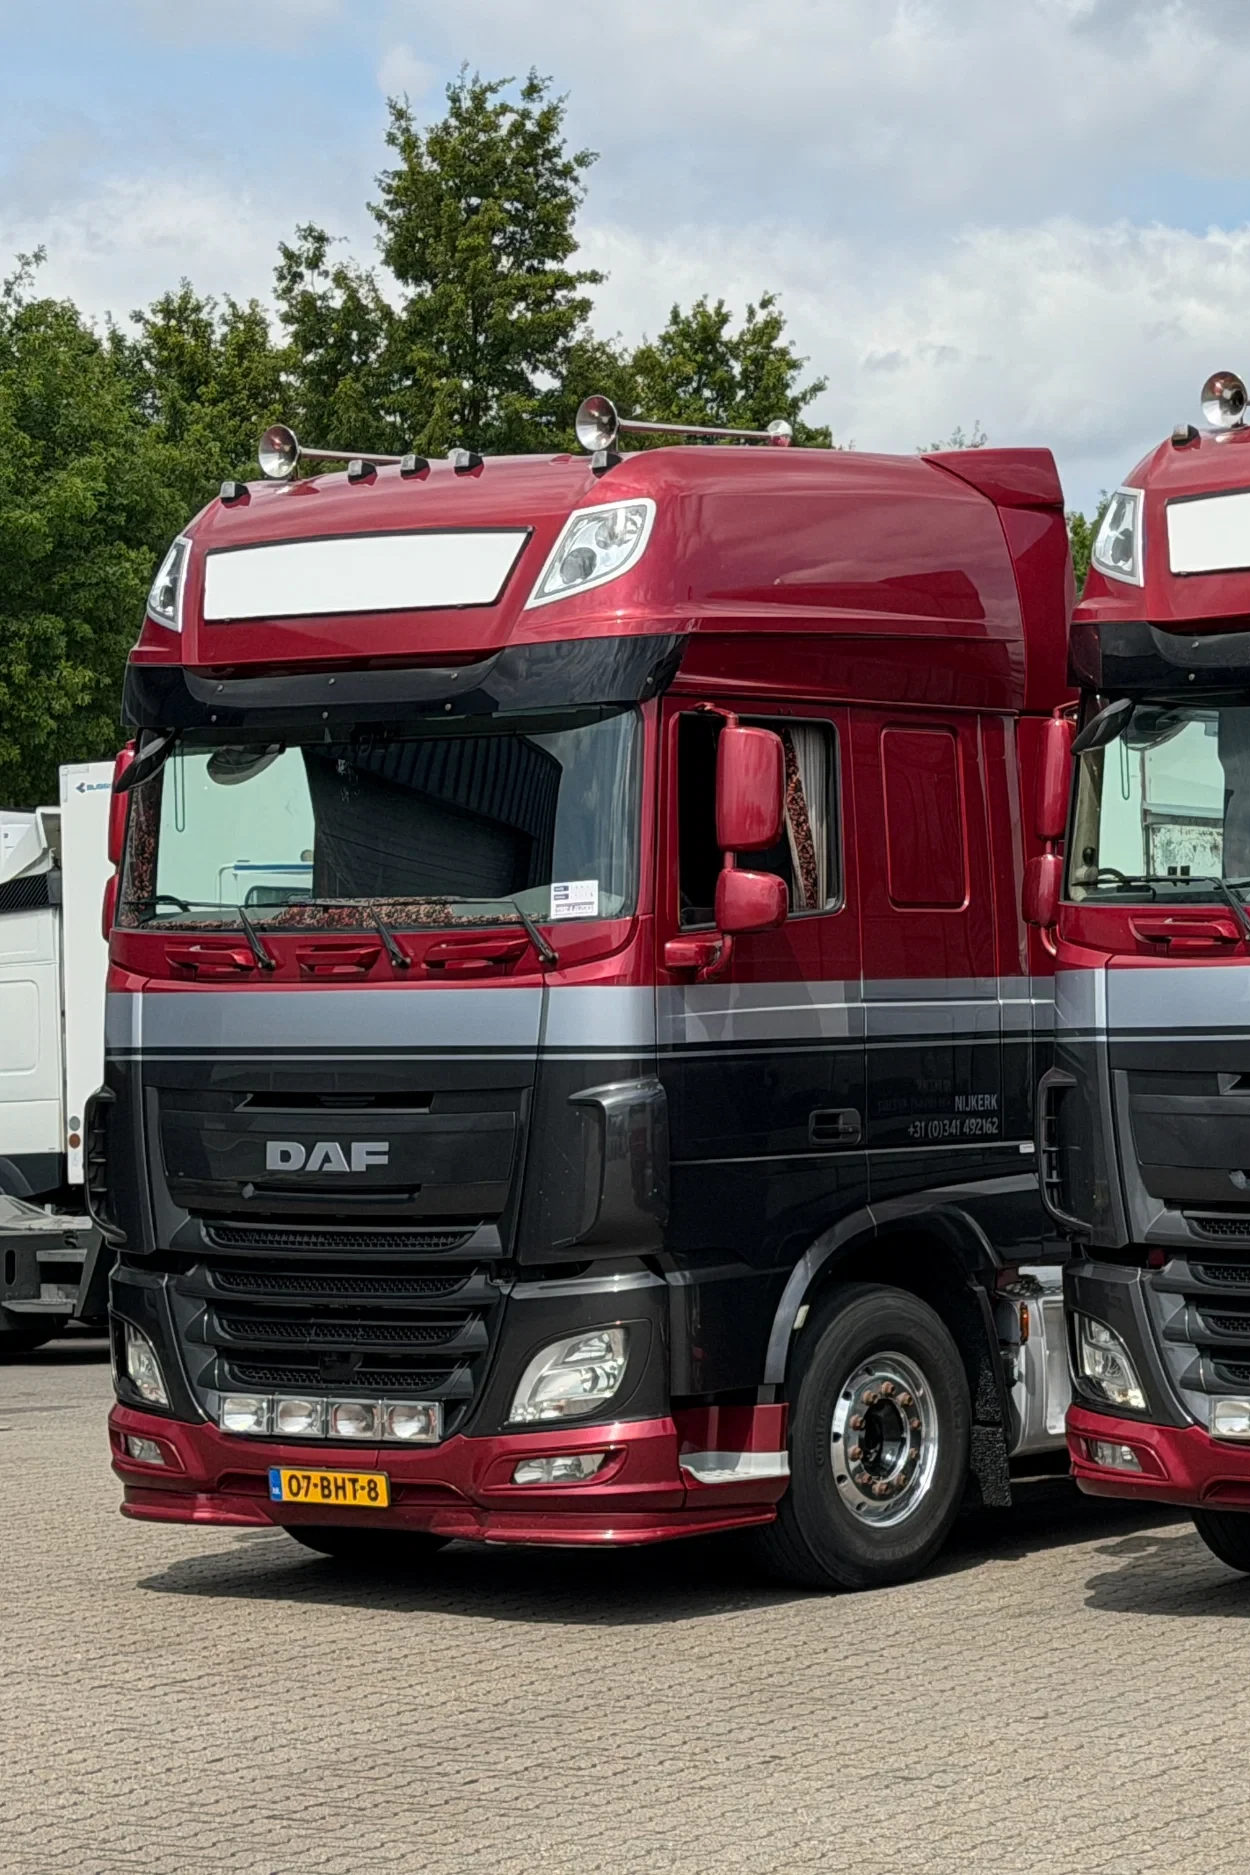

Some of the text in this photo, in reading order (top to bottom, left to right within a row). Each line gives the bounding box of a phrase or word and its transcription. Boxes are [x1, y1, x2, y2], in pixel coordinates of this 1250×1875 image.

[954, 1093, 998, 1112] NIJKERK
[908, 1117, 999, 1139] +31 (0)341 492162
[266, 1141, 389, 1172] DAF
[287, 1474, 379, 1502] 07-BHT-8
